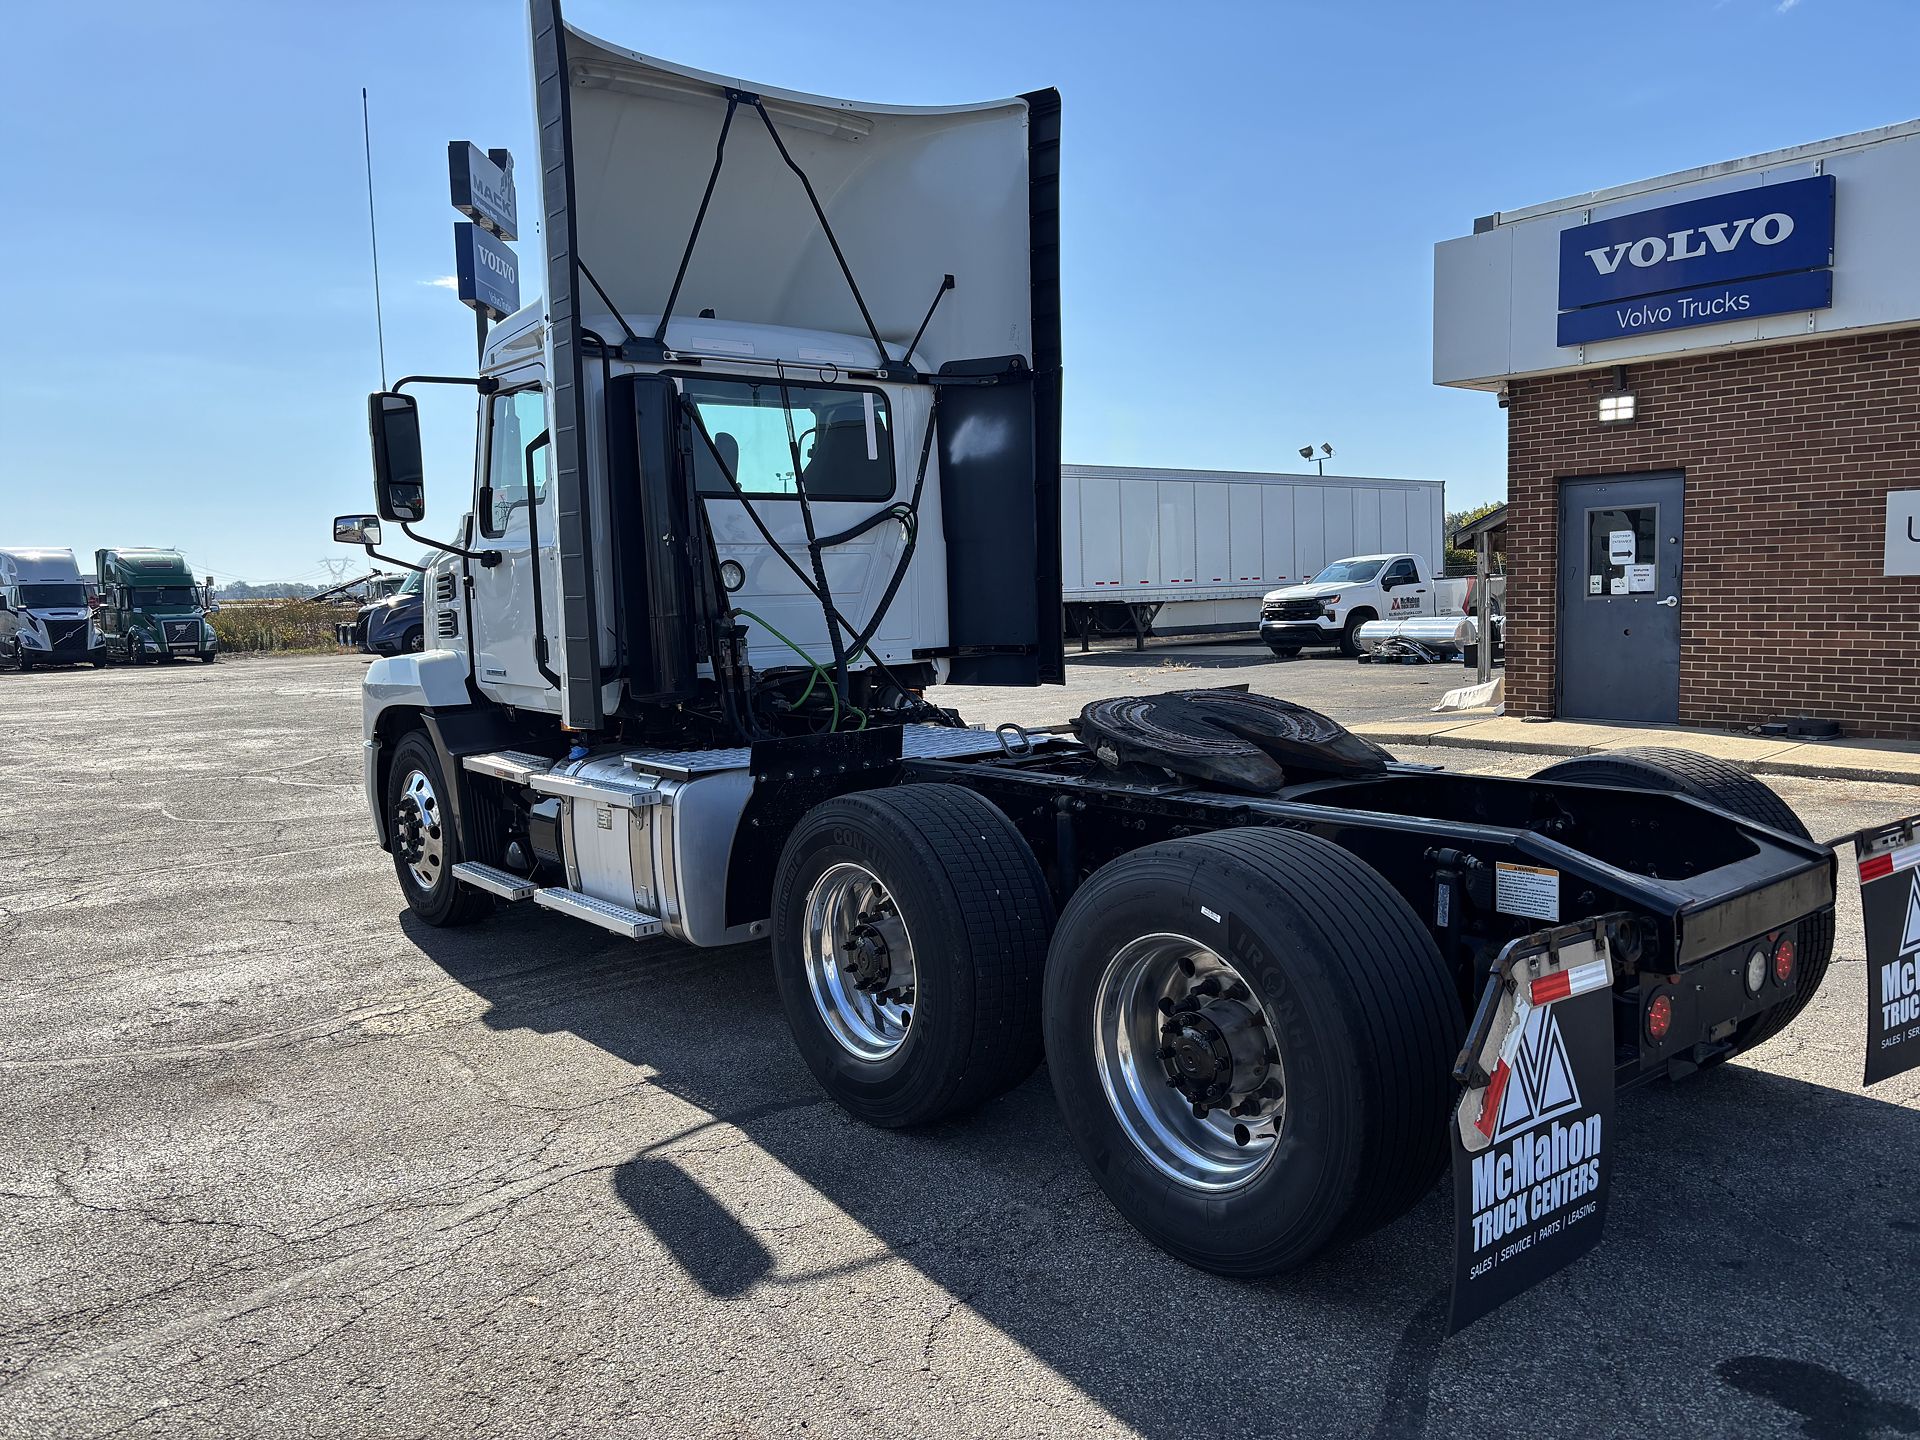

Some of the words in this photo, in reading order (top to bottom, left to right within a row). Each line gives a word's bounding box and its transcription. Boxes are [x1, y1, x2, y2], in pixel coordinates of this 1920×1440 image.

[473, 174, 512, 217] MACK
[478, 244, 515, 284] VOLVO
[1585, 213, 1794, 275] VOLVO
[1616, 304, 1672, 329] Volvo
[1678, 291, 1750, 319] Trucks
[1881, 1033, 1901, 1049] SALES
[1472, 1113, 1601, 1215] McMahon
[1472, 1191, 1528, 1253] TRUCK
[1531, 1158, 1600, 1220] CENTERS
[1470, 1256, 1492, 1280] SALES
[1500, 1235, 1532, 1262] SERVICE
[1539, 1219, 1561, 1241] PARTS
[1567, 1200, 1597, 1225] LEASING
